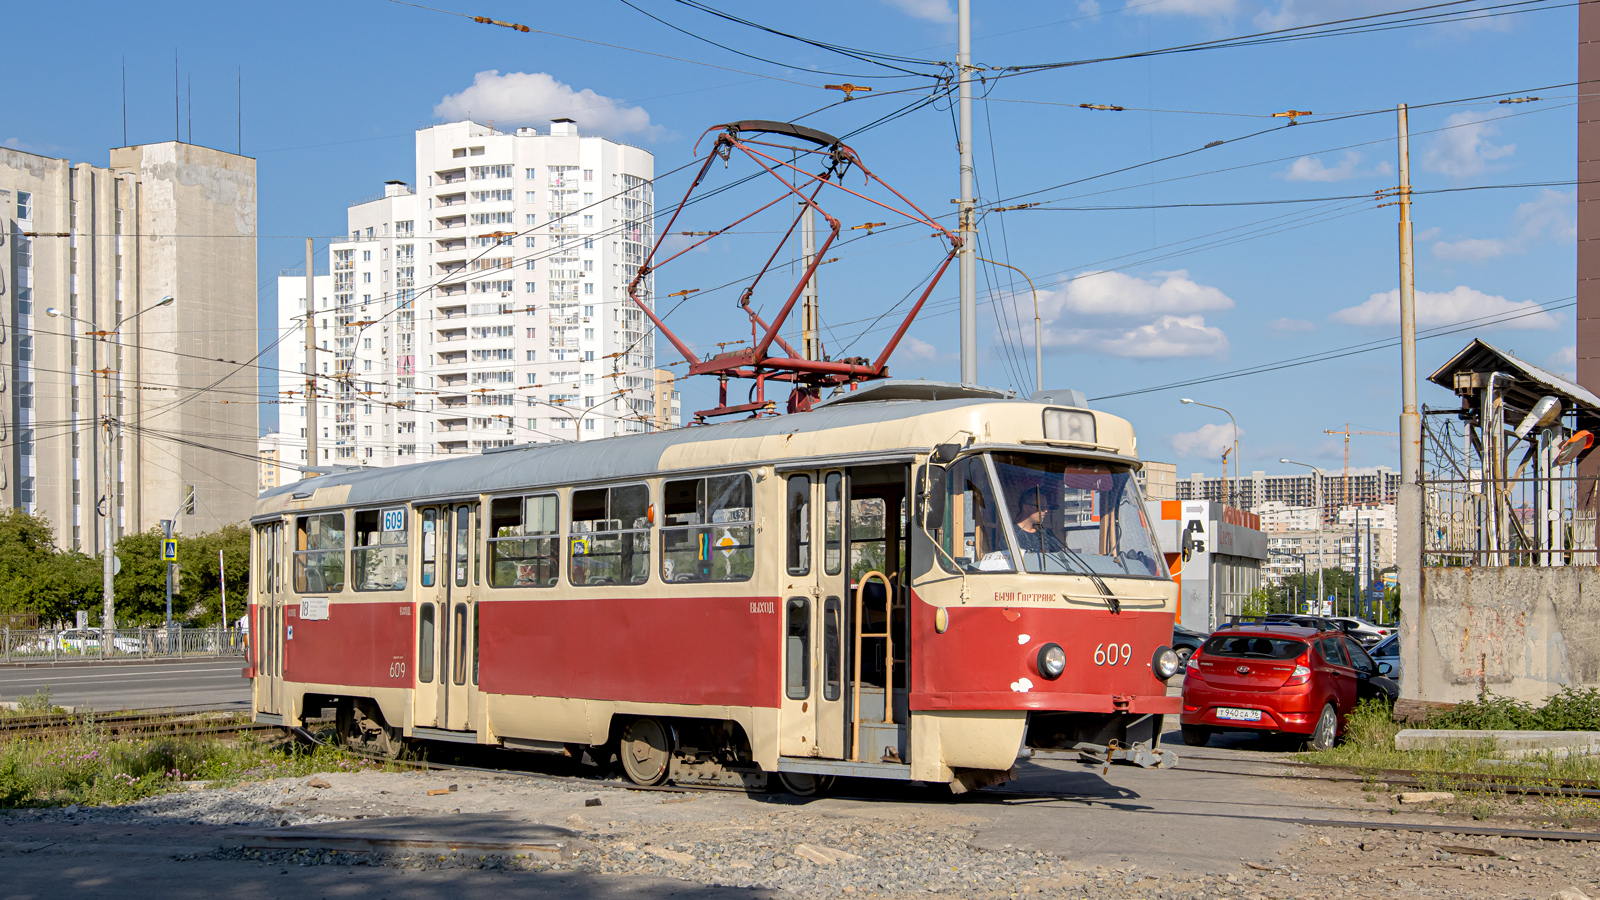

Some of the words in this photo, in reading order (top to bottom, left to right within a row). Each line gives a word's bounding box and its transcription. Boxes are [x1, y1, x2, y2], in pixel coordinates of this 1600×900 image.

[385, 511, 403, 530] 609
[750, 601, 774, 614] ВЫХОД
[1093, 643, 1133, 667] 609
[389, 662, 406, 679] 609
